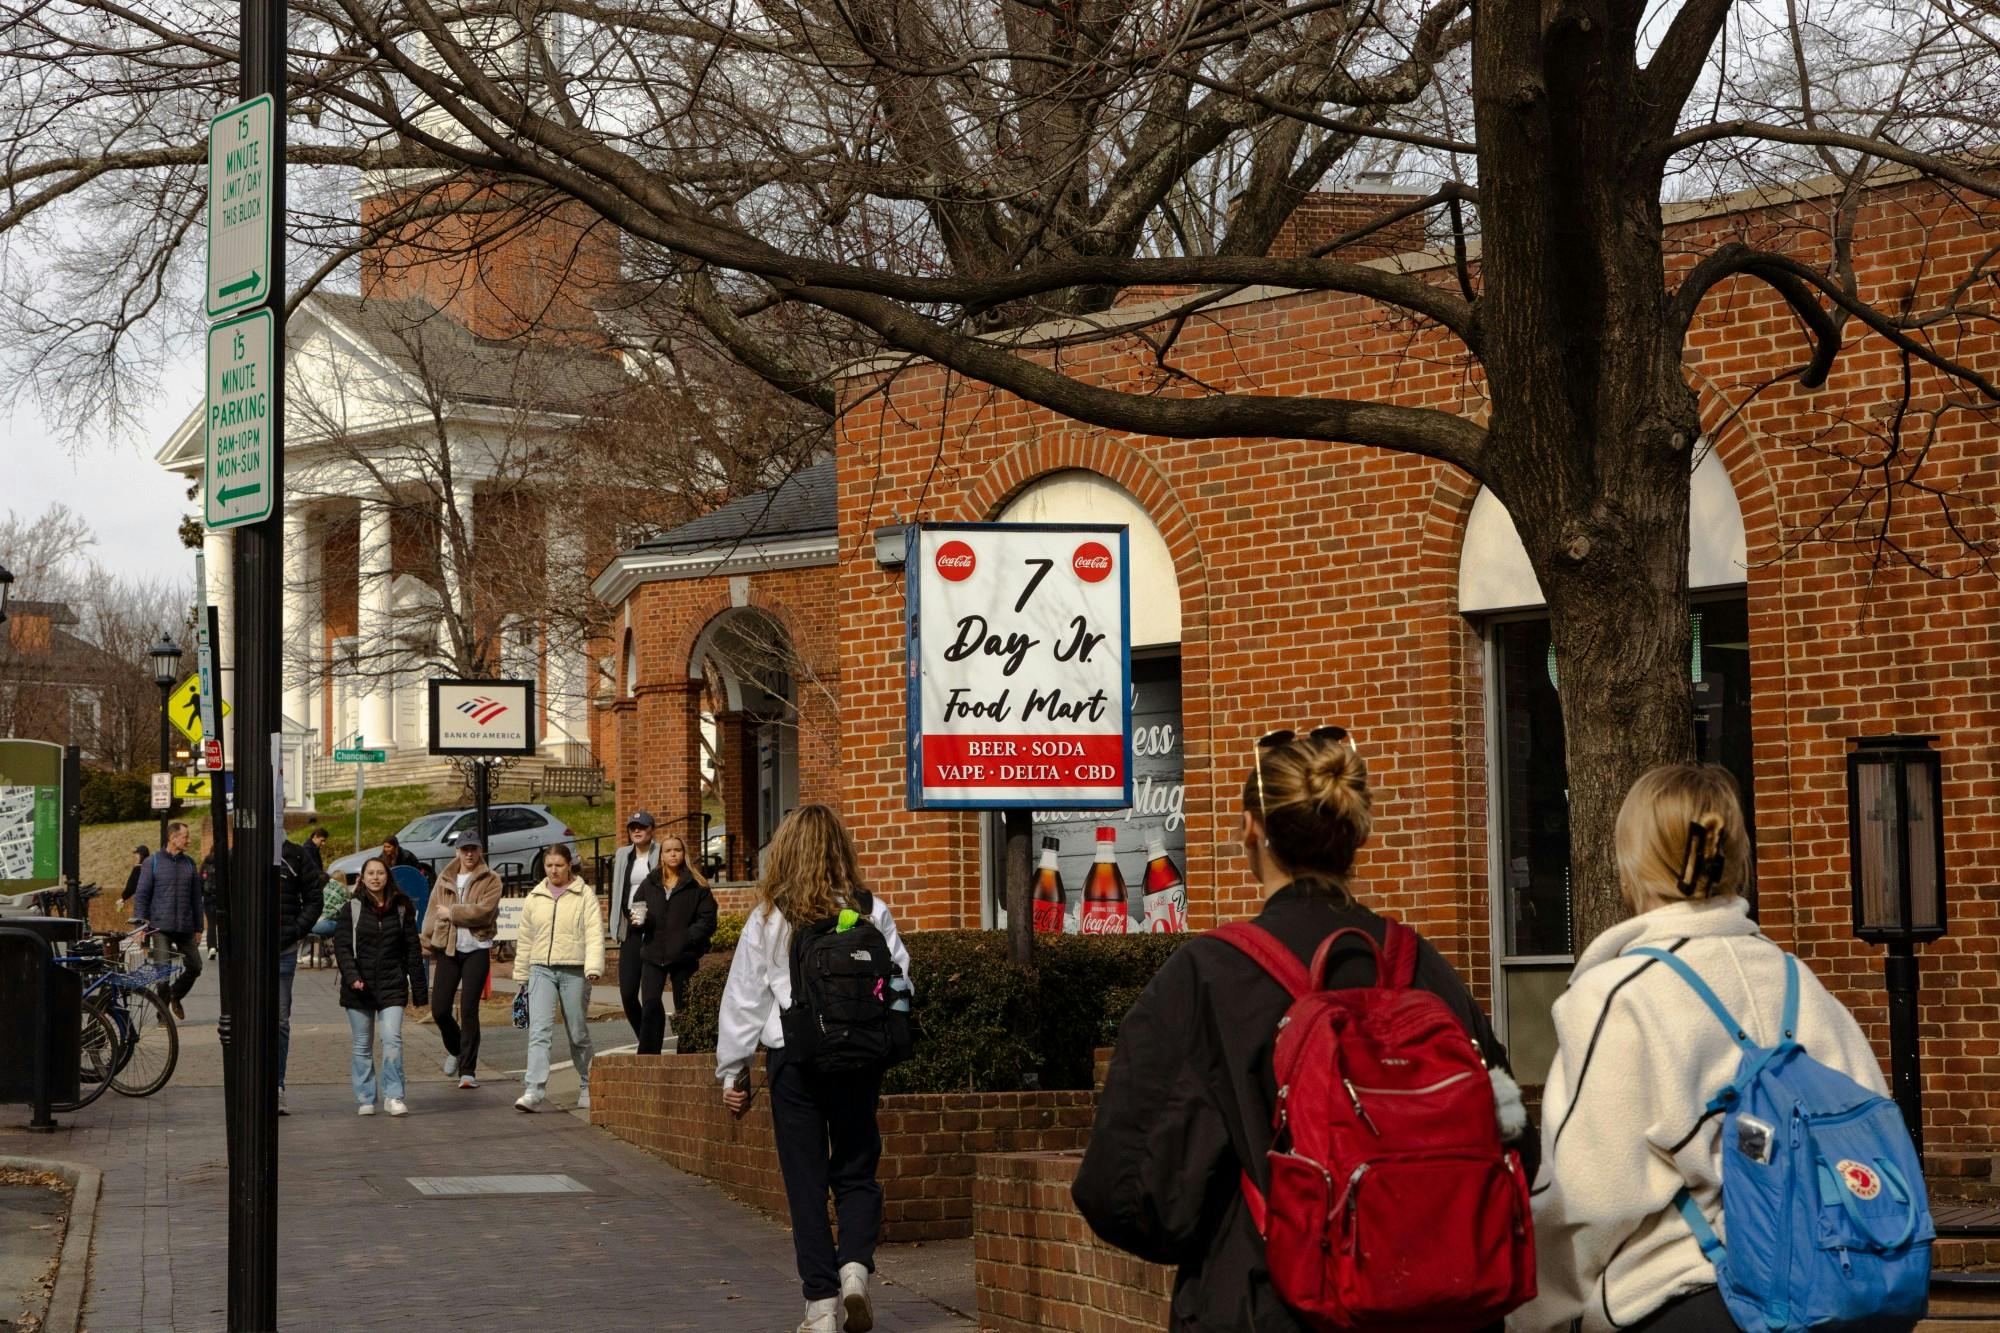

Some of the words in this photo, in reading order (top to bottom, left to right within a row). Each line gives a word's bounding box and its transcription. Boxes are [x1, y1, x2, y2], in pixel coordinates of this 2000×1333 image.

[237, 113, 249, 141] 15
[226, 141, 259, 177] MINUTE
[222, 169, 262, 202] LIMIT/DAY
[222, 205, 237, 229] THIS
[239, 197, 261, 222] BLOCK
[233, 334, 245, 361] 15
[222, 363, 256, 396] MINUTE
[212, 393, 265, 430] PARKING
[217, 428, 260, 456] 8AM-10PM
[217, 450, 260, 479] MON-SUN
[938, 554, 973, 567] Coca-Cola
[1075, 555, 1109, 568] Coca-Cola
[1014, 558, 1054, 613] 7
[943, 615, 1040, 677] Day
[1053, 615, 1106, 663] Jr.
[943, 688, 1011, 723] Food
[1021, 688, 1108, 723] Mart
[968, 742, 1018, 756] BEER
[1031, 741, 1086, 756] SODA
[1132, 724, 1175, 757] ess
[937, 765, 985, 780] VAPE
[1000, 765, 1060, 780] DELTA
[1074, 764, 1116, 780] CBD
[1125, 776, 1185, 832] Mag
